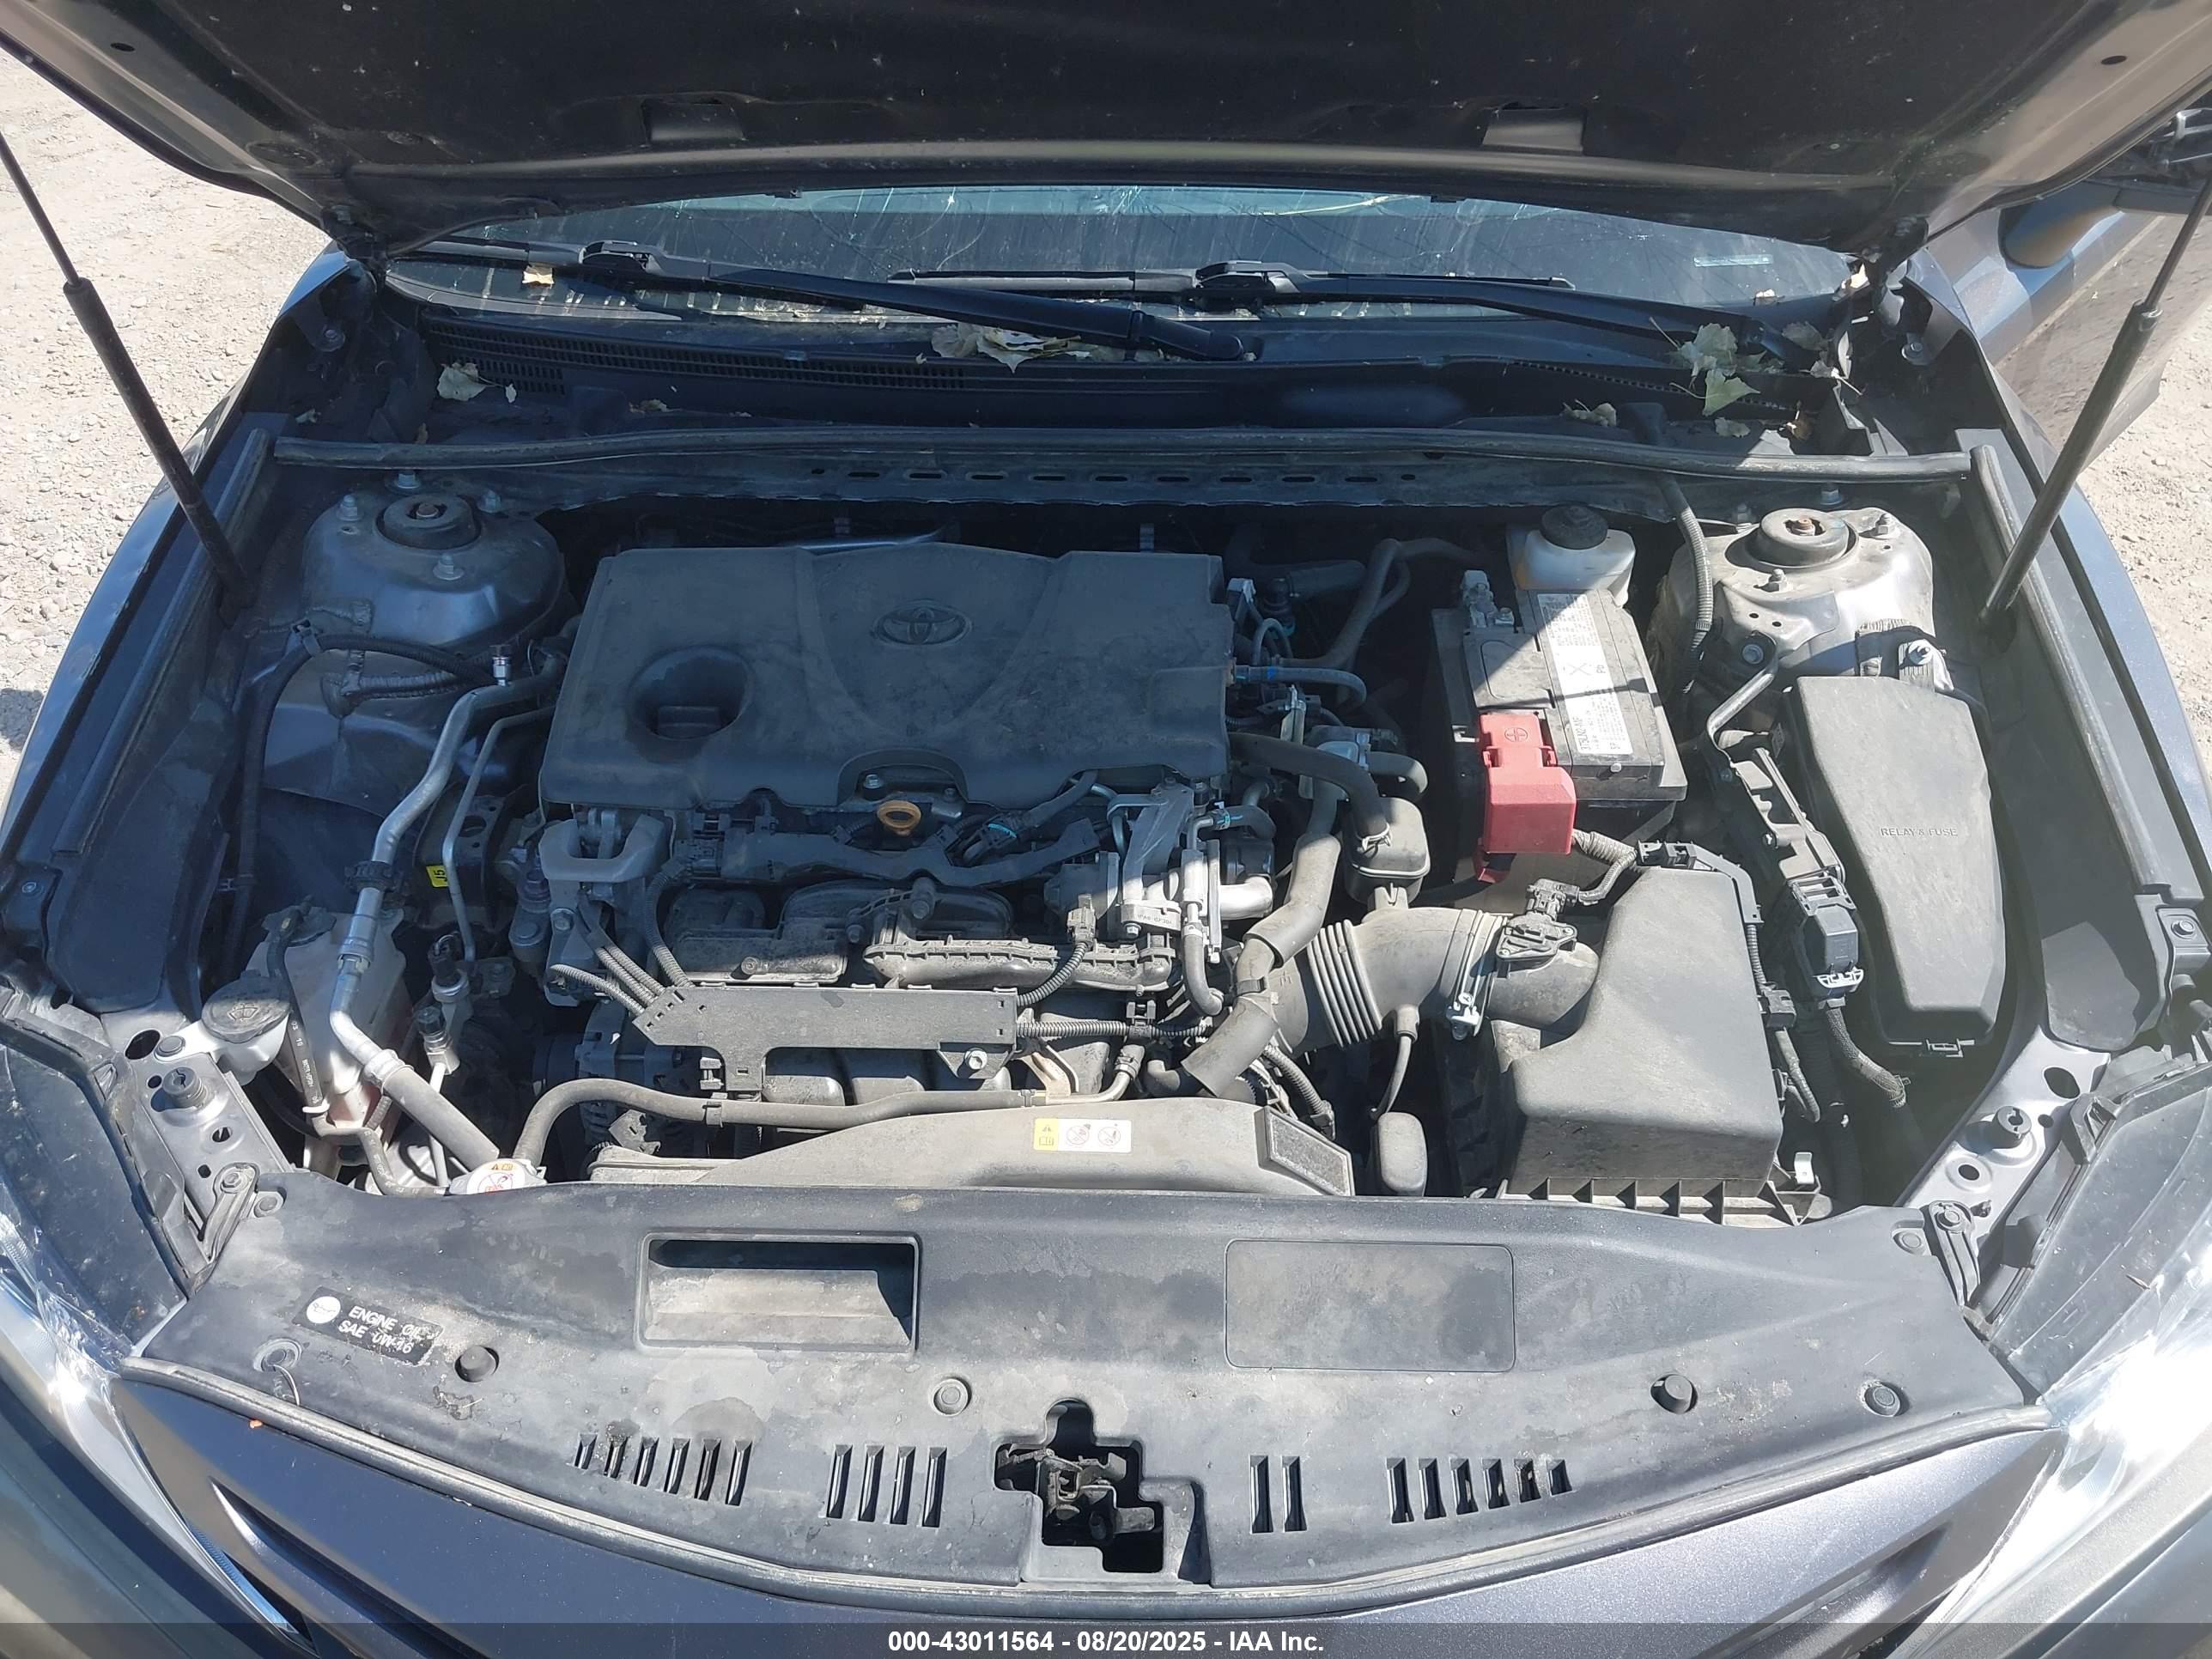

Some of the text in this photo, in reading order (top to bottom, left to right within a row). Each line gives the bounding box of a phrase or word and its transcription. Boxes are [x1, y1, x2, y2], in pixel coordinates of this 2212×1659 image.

[1881, 828, 1915, 836] RELAY
[1929, 828, 1958, 836] FUSE
[349, 1305, 398, 1331] ENGINE
[338, 1320, 369, 1339] SAE
